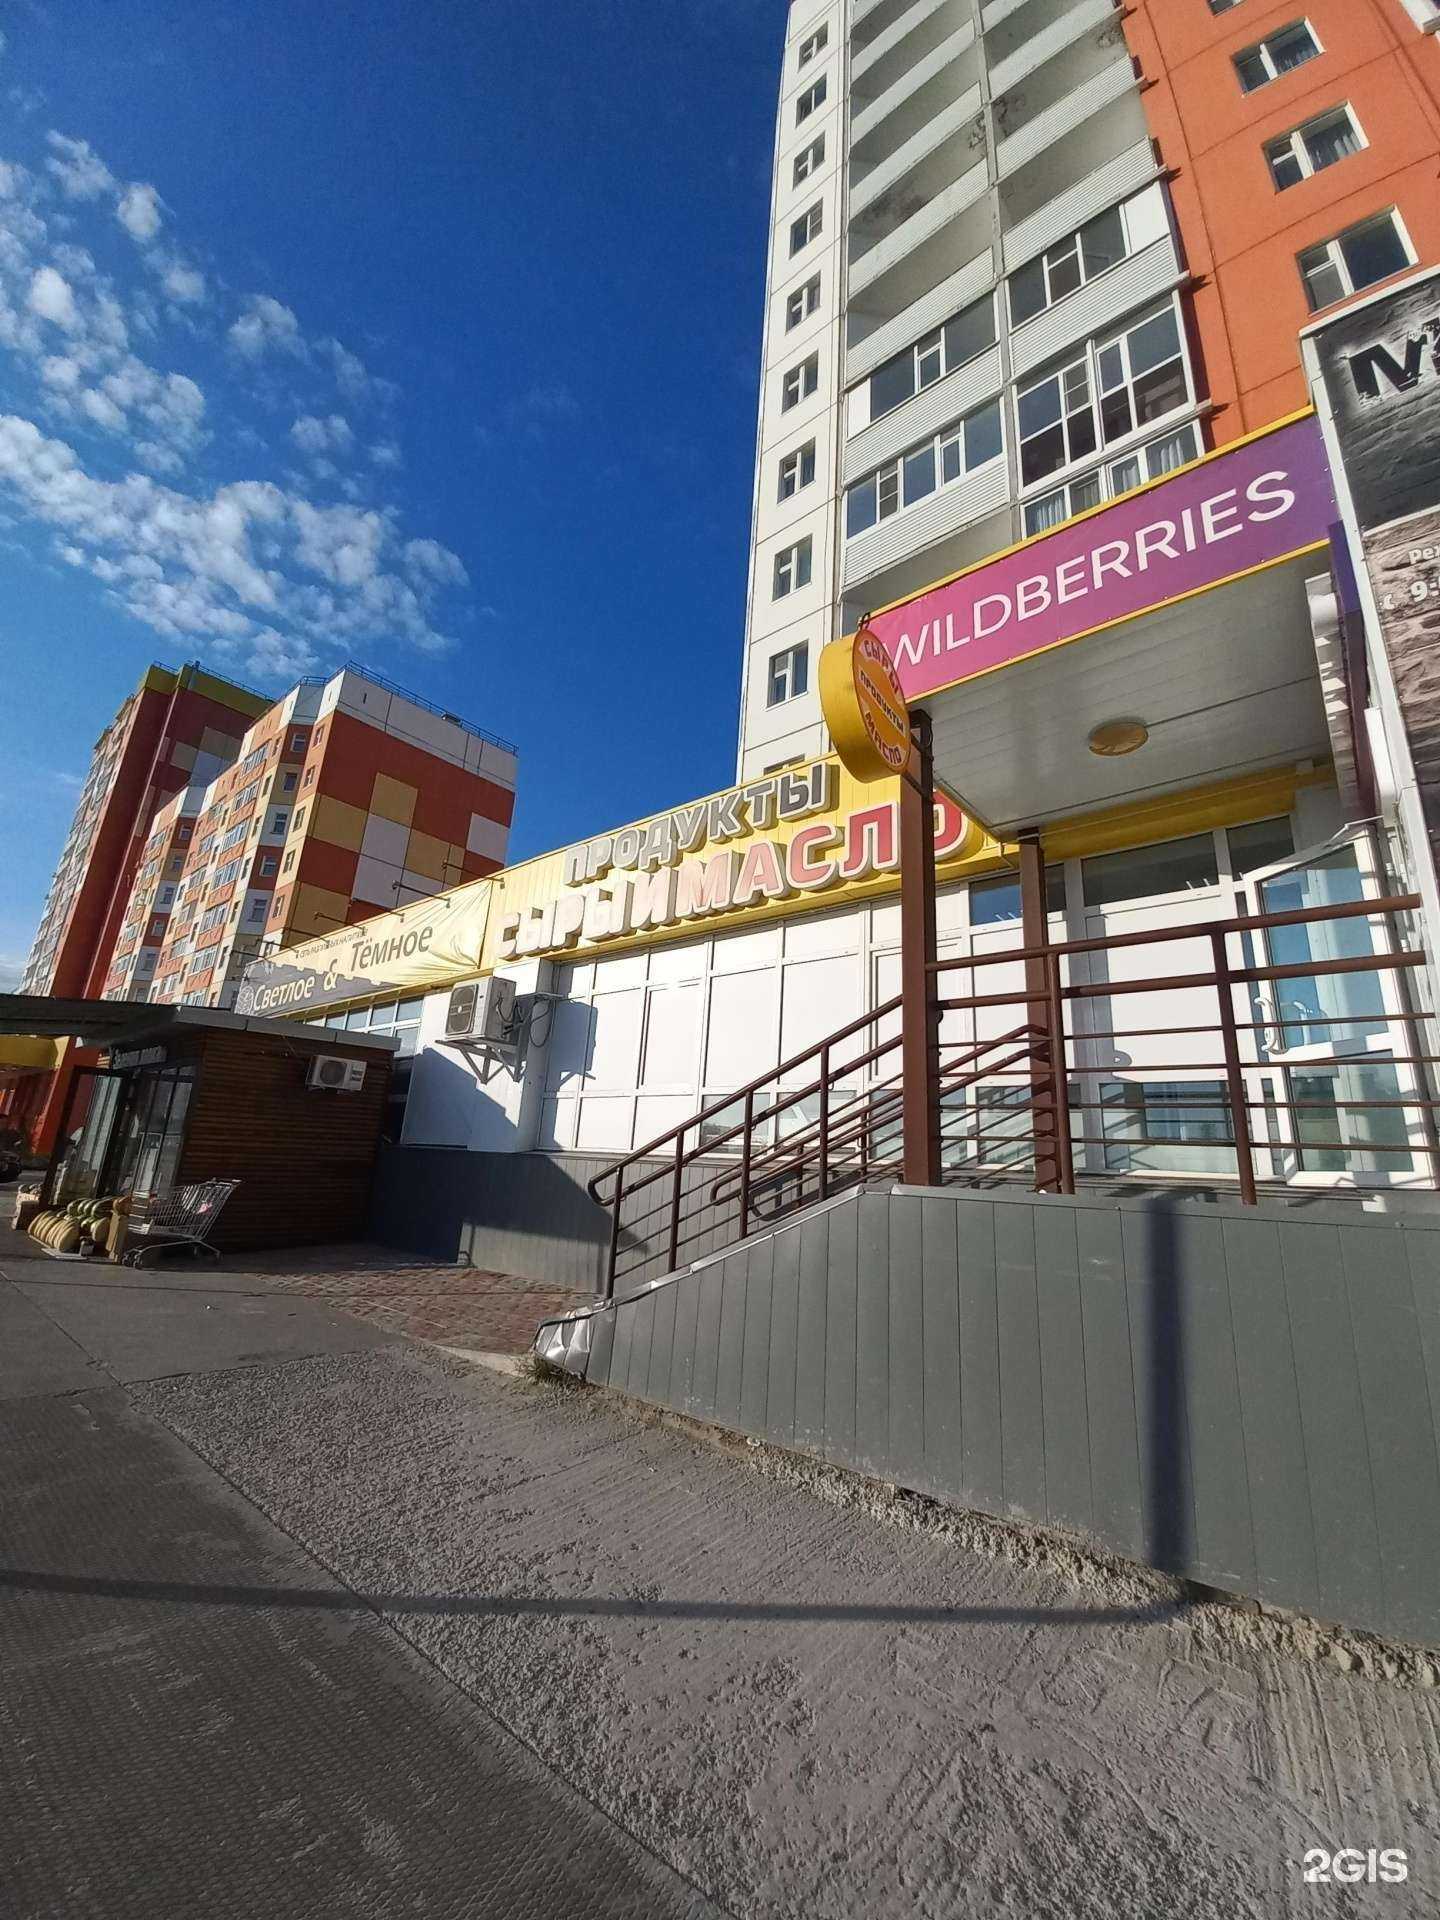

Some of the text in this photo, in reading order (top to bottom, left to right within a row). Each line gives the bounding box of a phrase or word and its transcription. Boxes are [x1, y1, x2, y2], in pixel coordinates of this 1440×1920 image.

[882, 470, 1296, 672] WILDBERRIES
[564, 762, 830, 886] ПРОДУКТЫ
[253, 975, 315, 1011] Светлое
[350, 926, 433, 972] Тёмное
